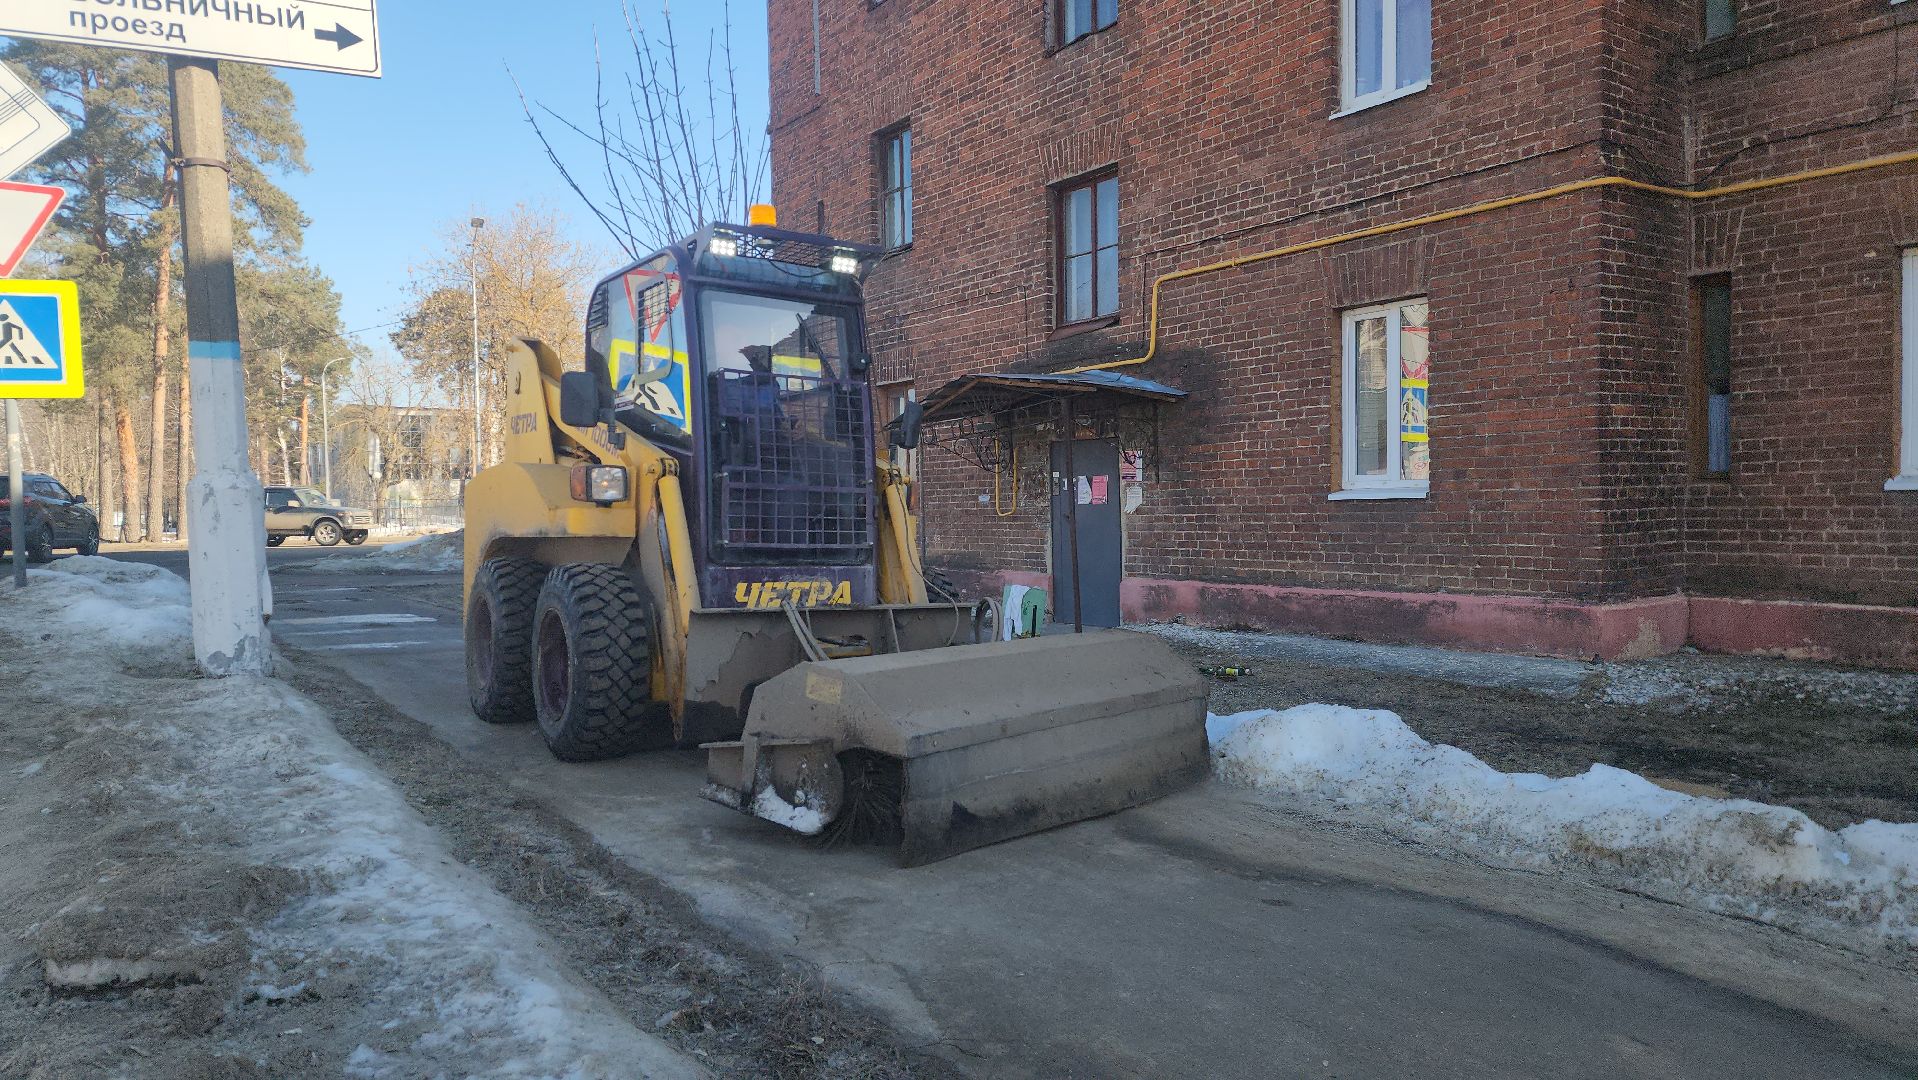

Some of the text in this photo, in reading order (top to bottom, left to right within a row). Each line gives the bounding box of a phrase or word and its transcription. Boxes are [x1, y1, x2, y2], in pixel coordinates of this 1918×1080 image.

[69, 10, 186, 43] проезд
[73, 0, 305, 30] ьничный
[511, 412, 537, 435] ЧЕТРА
[735, 581, 852, 608] ЧЕТРА
